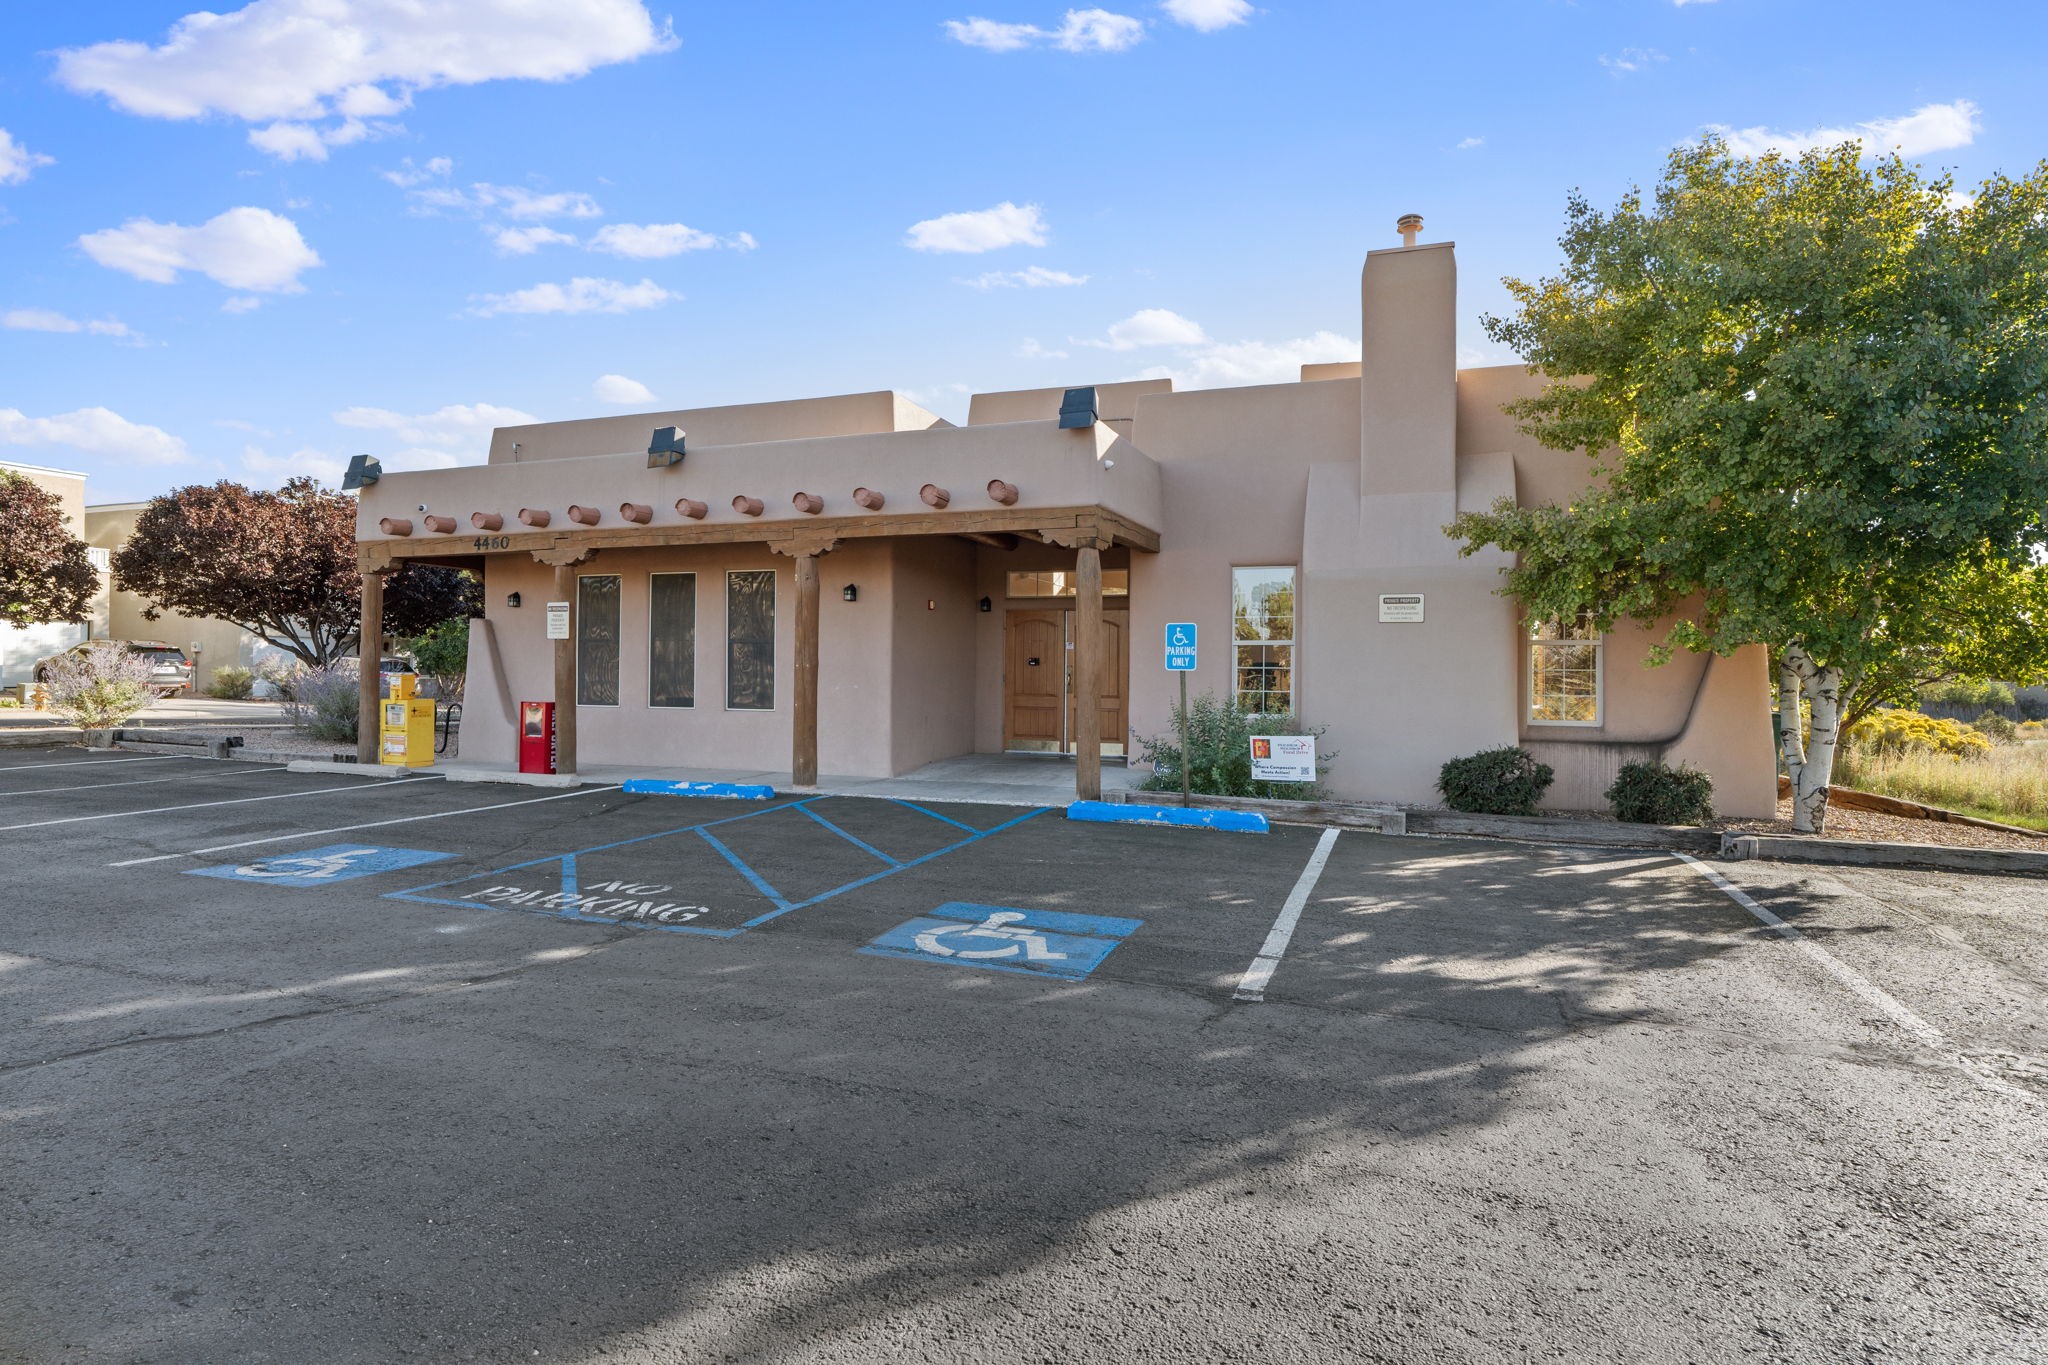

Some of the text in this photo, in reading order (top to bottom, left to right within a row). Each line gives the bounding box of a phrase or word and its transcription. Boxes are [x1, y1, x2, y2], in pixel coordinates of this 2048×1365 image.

[473, 536, 510, 551] 4460
[1167, 646, 1195, 656] PARKING
[1172, 657, 1189, 667] ONLY
[584, 880, 673, 895] NO
[460, 885, 709, 922] PARKING
